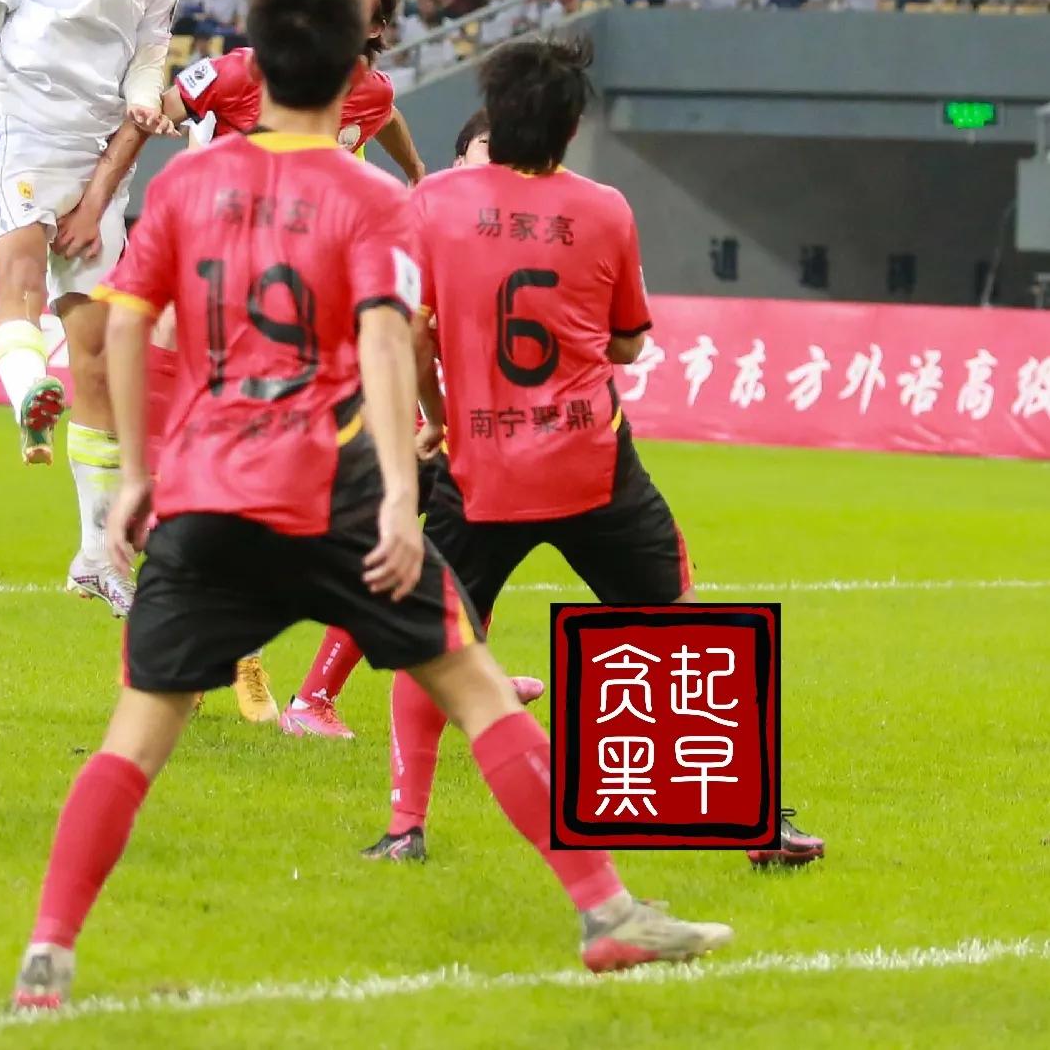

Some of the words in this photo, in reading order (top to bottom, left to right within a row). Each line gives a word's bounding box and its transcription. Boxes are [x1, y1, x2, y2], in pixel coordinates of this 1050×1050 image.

[476, 208, 575, 246] 易家亮
[196, 261, 319, 402] 19
[496, 268, 560, 387] 6
[470, 399, 595, 440] 南宁聚鼎
